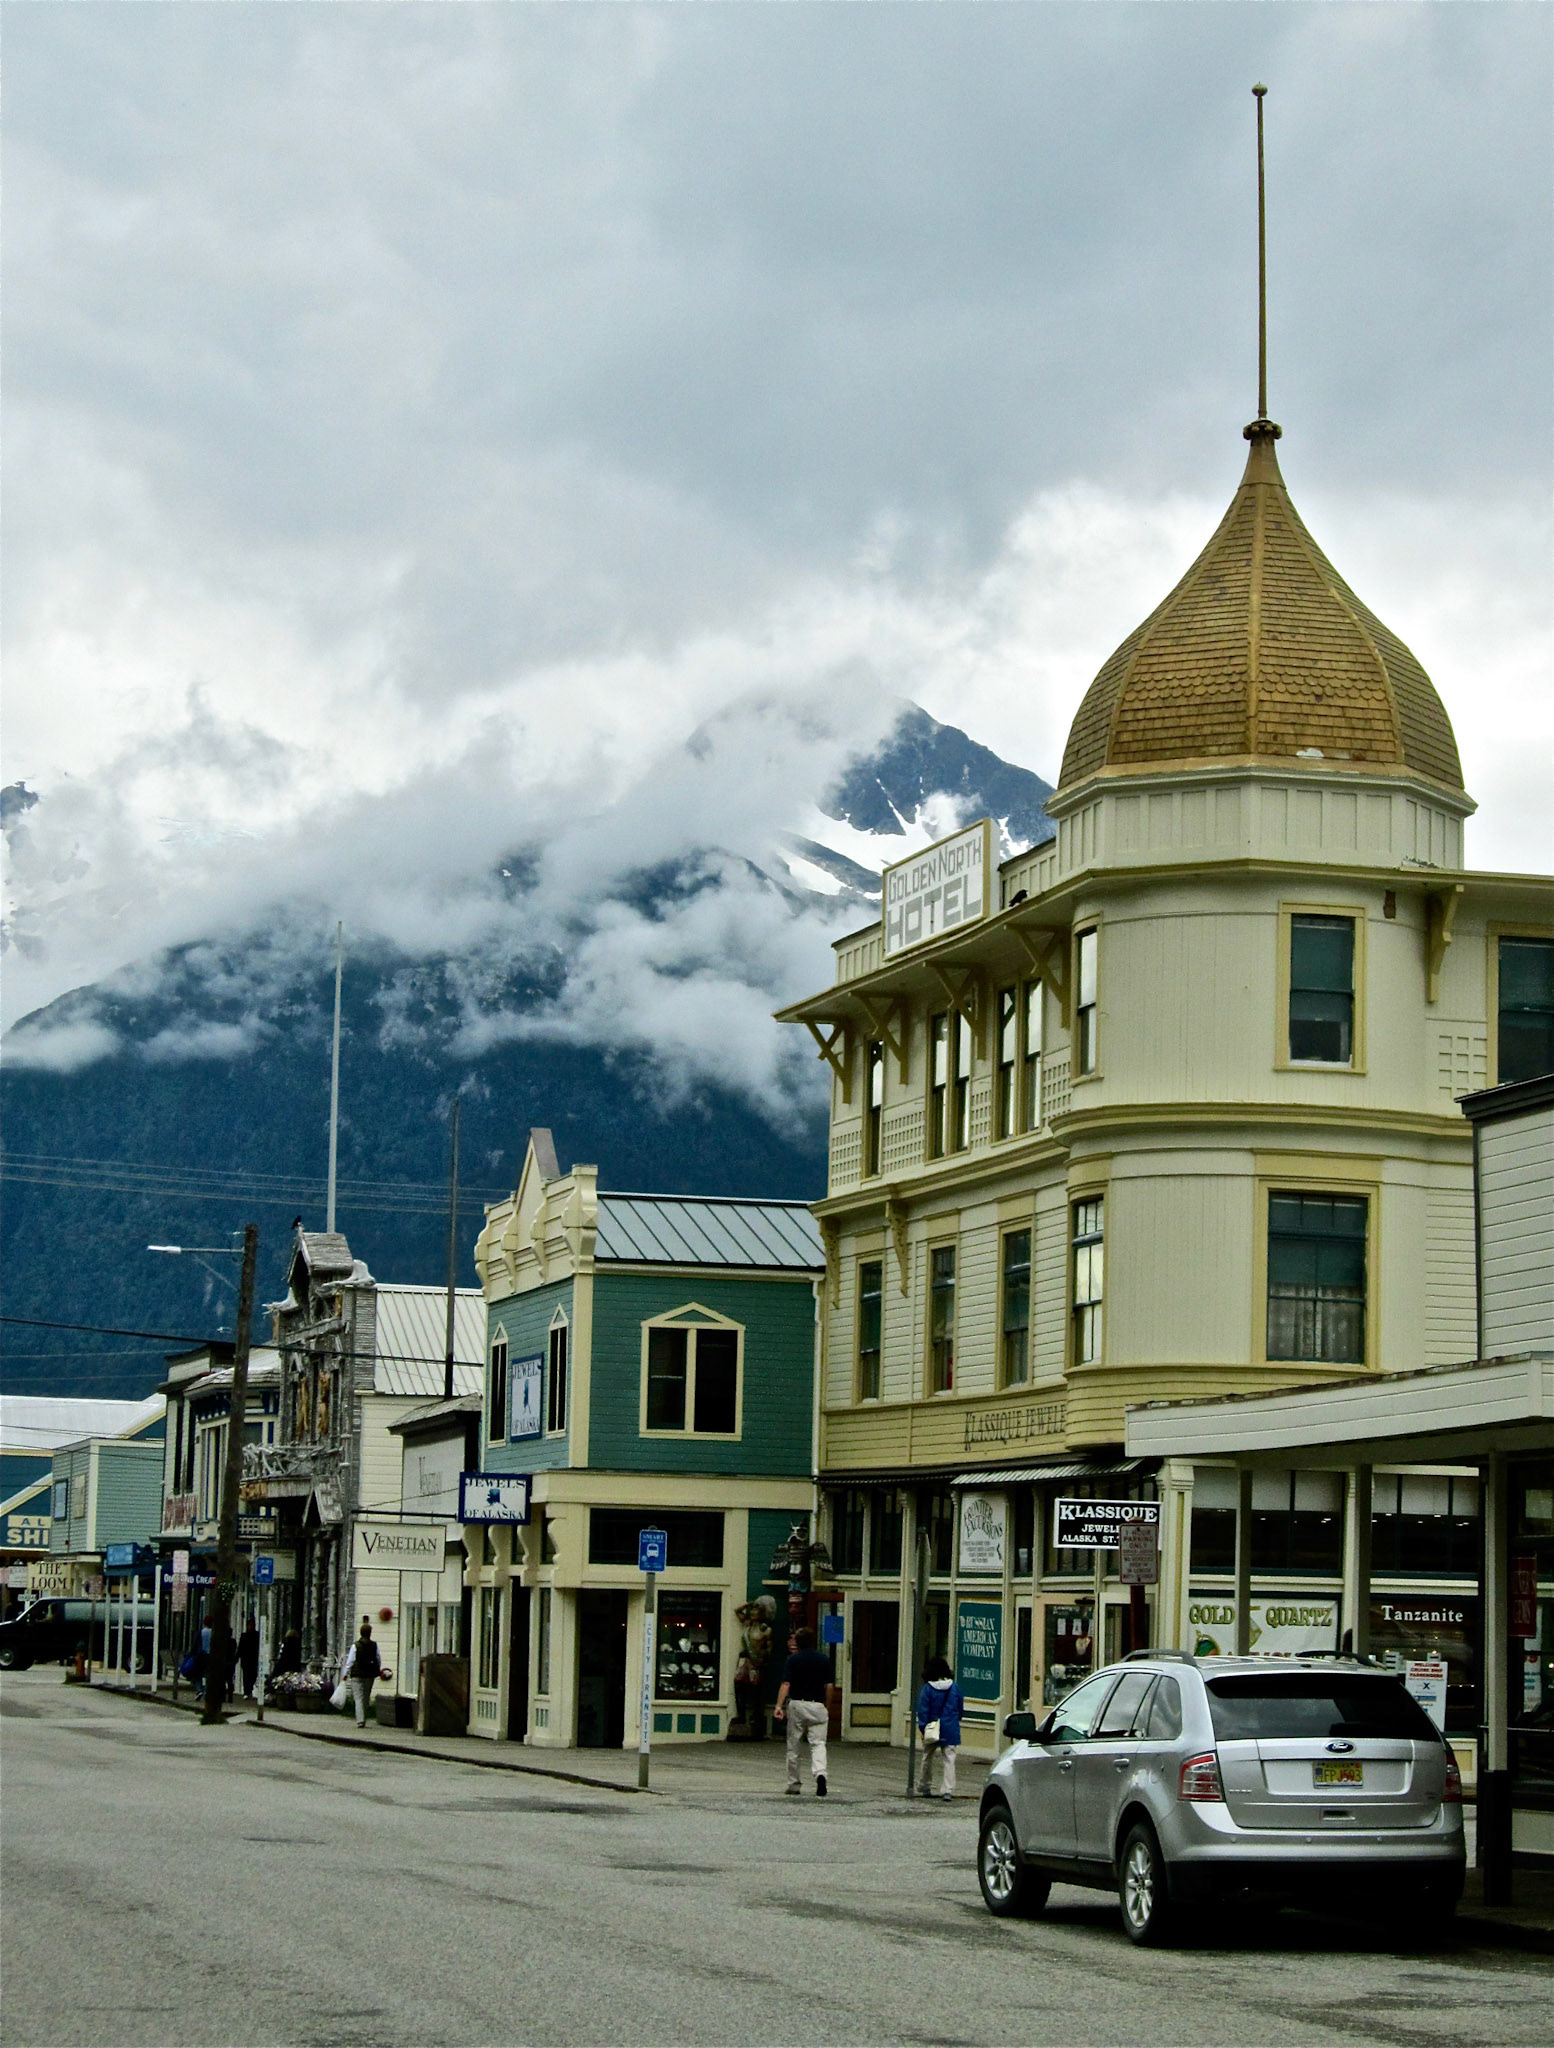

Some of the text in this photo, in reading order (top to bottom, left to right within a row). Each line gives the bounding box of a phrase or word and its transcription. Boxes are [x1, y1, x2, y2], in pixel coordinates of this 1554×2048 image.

[888, 836, 981, 905] GOLDEN NORTH
[886, 873, 982, 954] HOTEL
[964, 1410, 1022, 1452] KLASSIQUE
[465, 1478, 527, 1489] JEWELS
[464, 1508, 524, 1520] OF ALASKA
[964, 1499, 993, 1526] FRONTIER
[1059, 1504, 1158, 1523] KLASSIQUE
[966, 1514, 1003, 1540] EXCURSIONS
[1081, 1524, 1120, 1533] JEWEL
[361, 1531, 438, 1555] VENETIAN
[1061, 1534, 1098, 1543] ALASKA
[37, 1562, 62, 1576] THE
[31, 1576, 68, 1590] LOOM
[1189, 1604, 1333, 1628] GOLD QUARTZ
[1381, 1604, 1464, 1622] Tanzanite
[966, 1615, 995, 1631] RUSSIAN
[963, 1629, 998, 1645] AMERICAN
[962, 1643, 995, 1658] COMPANY
